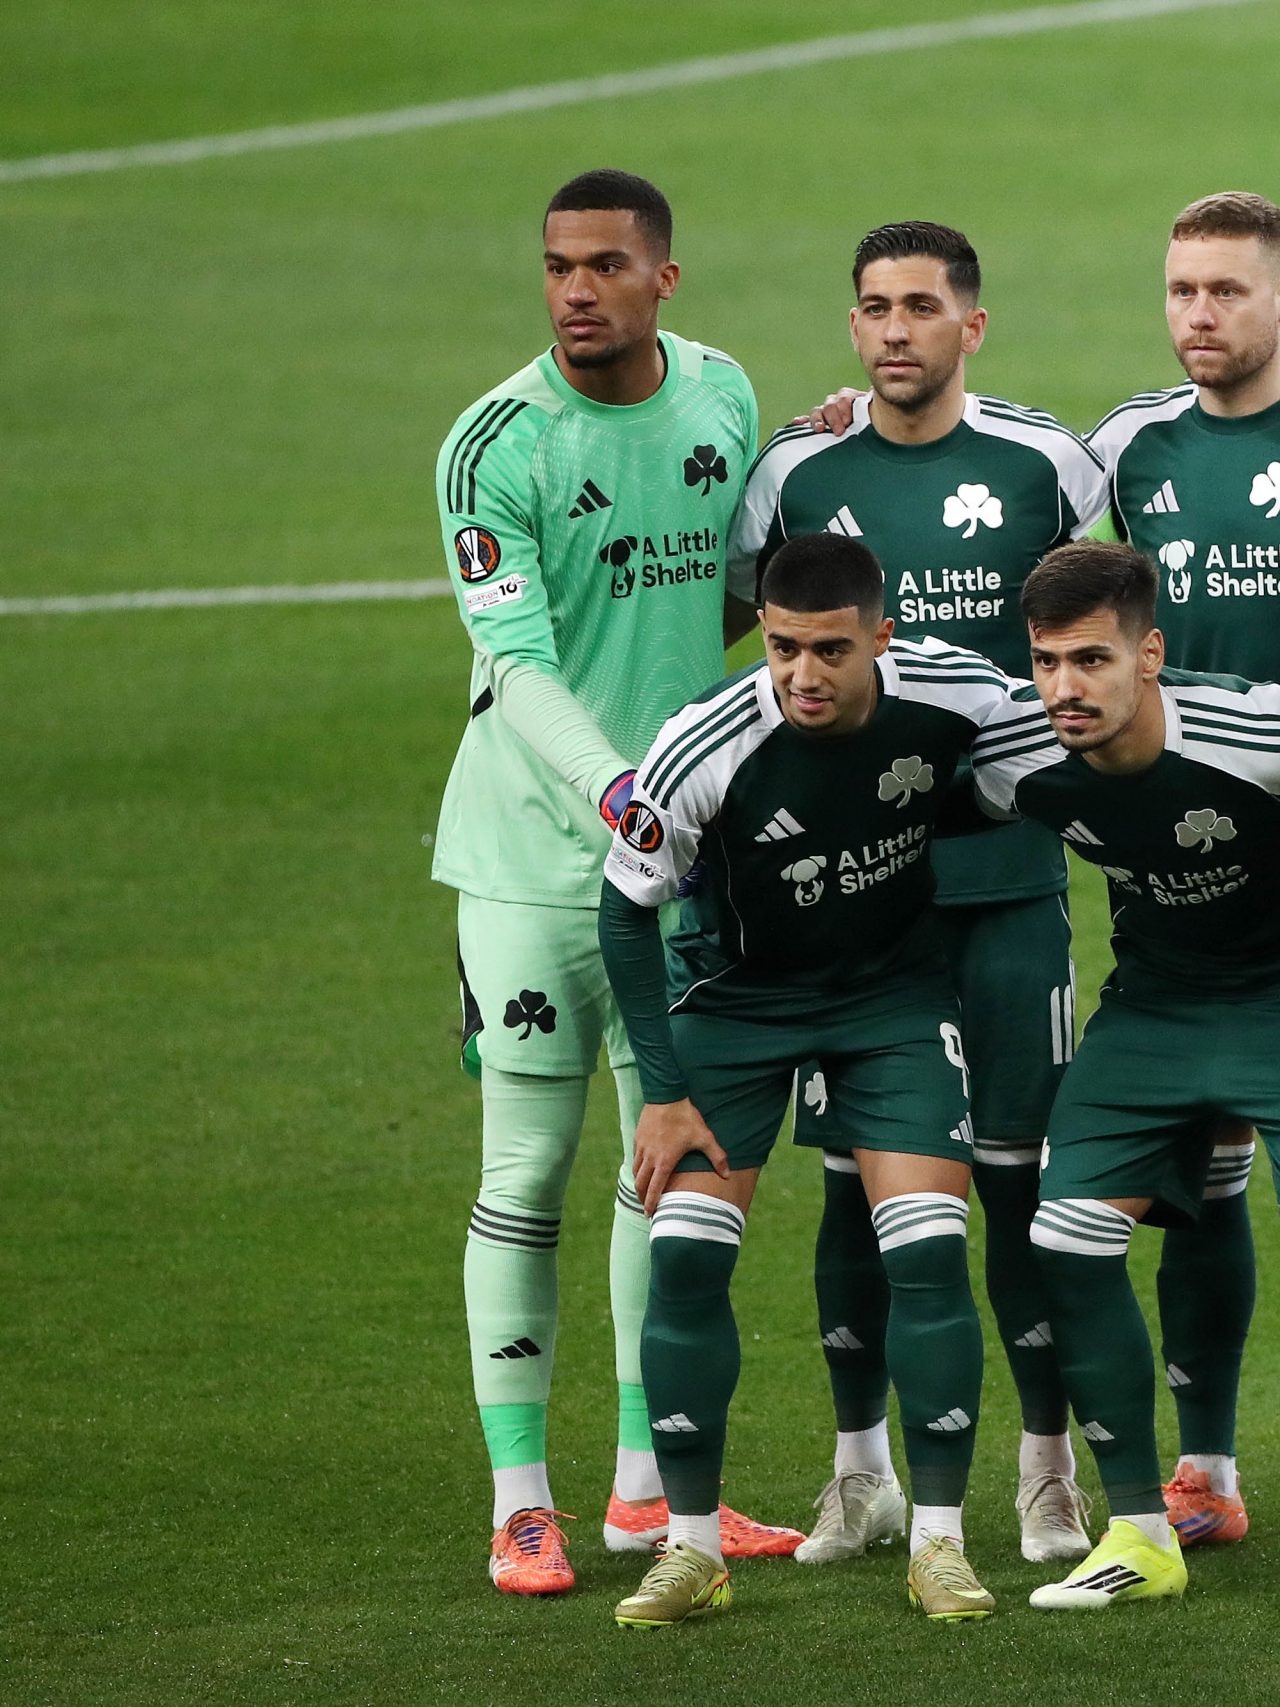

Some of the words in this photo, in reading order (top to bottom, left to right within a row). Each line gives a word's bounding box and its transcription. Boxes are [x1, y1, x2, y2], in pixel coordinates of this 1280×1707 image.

[643, 536, 658, 559] A
[663, 528, 718, 557] Little
[1205, 544, 1226, 569] A
[641, 558, 719, 588] Shelte
[897, 570, 920, 595] A
[925, 566, 1002, 594] Little
[899, 596, 1005, 623] Shelter
[837, 850, 859, 872] A
[862, 824, 926, 866] Little
[839, 838, 926, 894] Shelter
[1148, 872, 1166, 890] A
[1167, 865, 1242, 889] Little
[1153, 873, 1249, 906] Shelter
